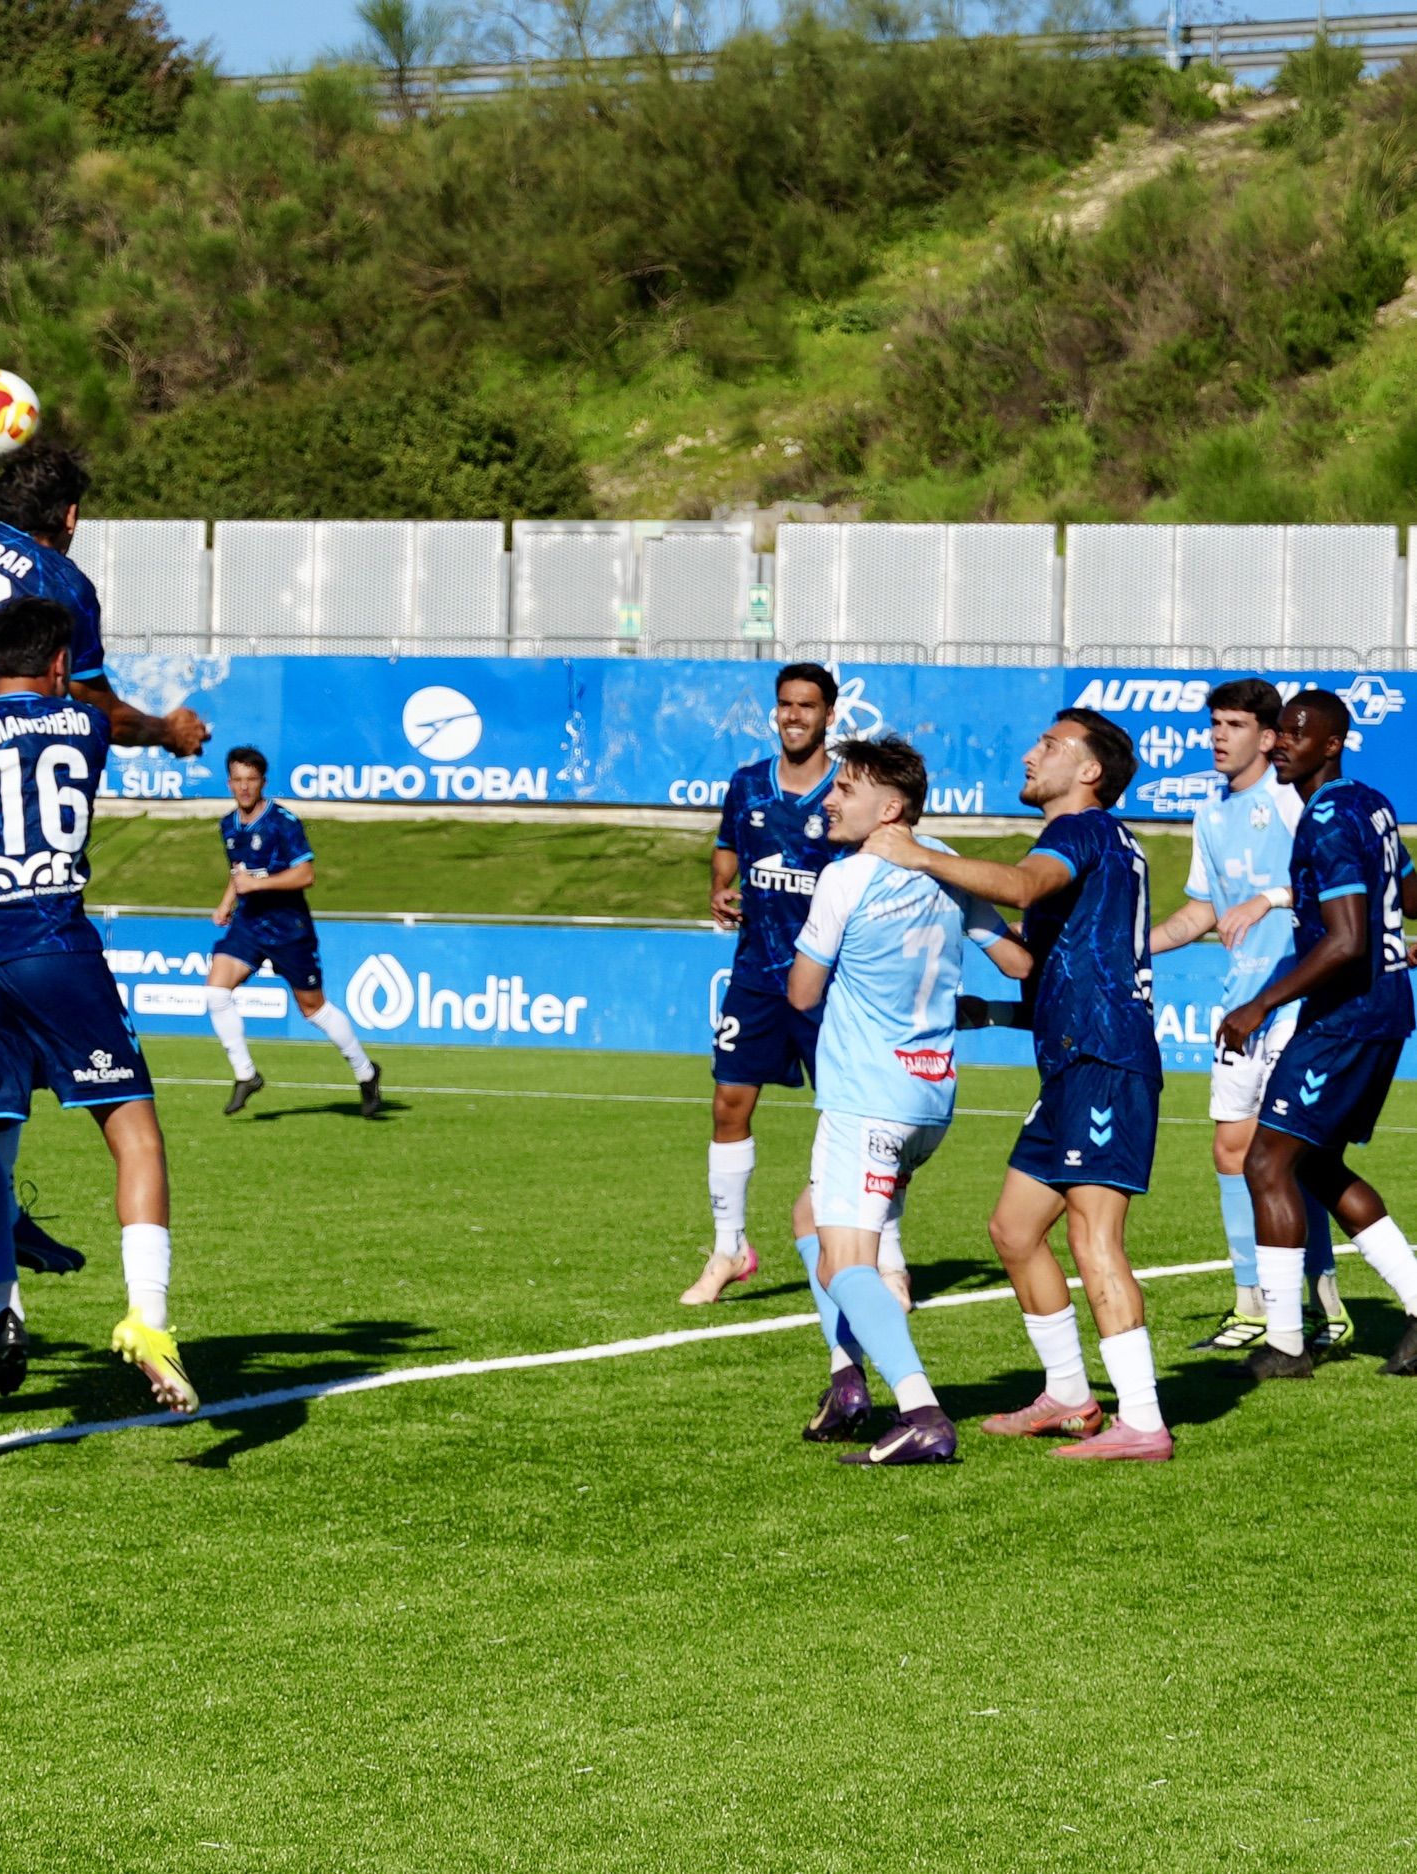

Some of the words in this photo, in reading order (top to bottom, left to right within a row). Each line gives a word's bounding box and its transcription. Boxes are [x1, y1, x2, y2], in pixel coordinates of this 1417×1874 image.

[1073, 679, 1211, 712] AUTOS
[121, 770, 184, 799] SUR
[290, 763, 426, 799] GRUPO
[750, 867, 818, 895] LOTUS
[902, 924, 945, 1031] 7
[417, 971, 587, 1035] Inditer
